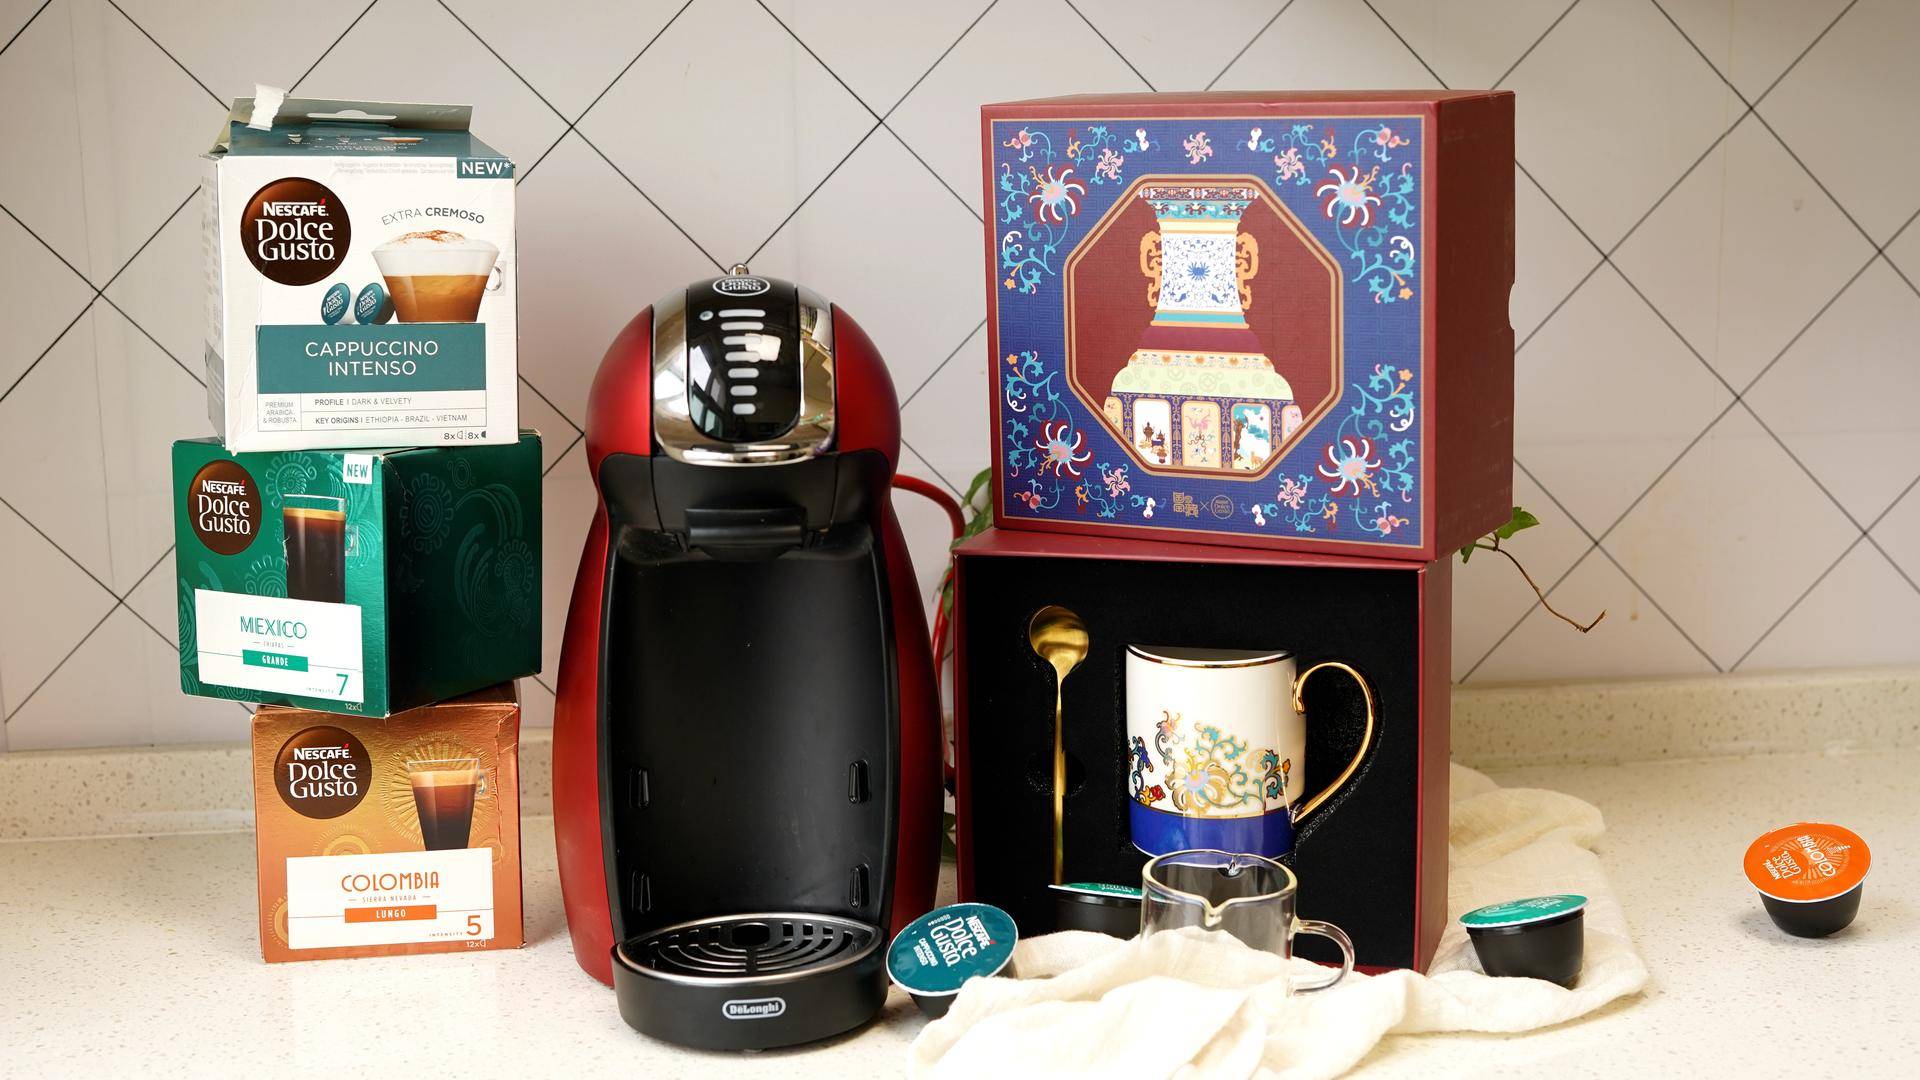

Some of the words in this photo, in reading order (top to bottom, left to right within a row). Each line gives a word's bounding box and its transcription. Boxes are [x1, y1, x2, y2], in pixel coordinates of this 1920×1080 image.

[381, 208, 423, 226] EXTRA
[425, 206, 485, 224] CREMOSO
[254, 217, 334, 241] Dolce
[257, 239, 336, 261] Gusto
[305, 340, 439, 357] CAPPUCCINO
[328, 360, 417, 377] INTENSO
[314, 398, 345, 406] PROFILE
[351, 397, 372, 406] DARK
[380, 396, 412, 405] VELVETY
[268, 416, 297, 424] ROBUSTA
[315, 416, 331, 425] KEY
[331, 415, 359, 425] ORIGINS
[365, 415, 399, 424] ETHIOPIA
[405, 414, 430, 423] BRAZIL
[436, 413, 468, 422] VIETNAM
[346, 463, 369, 479] NEW
[196, 494, 250, 518] Dolce
[199, 512, 251, 535] Gusto
[240, 615, 308, 639] MEXICO
[261, 654, 289, 667] GRANDE
[336, 673, 349, 696] 7
[286, 760, 357, 782] Dolce
[289, 779, 359, 799] Gusto
[1797, 835, 1838, 878] COLOMBIA
[341, 871, 440, 893] COLOMBIA
[362, 895, 388, 903] SIERRA
[389, 894, 417, 902] NEVADA
[375, 908, 407, 919] LUNGO
[466, 914, 483, 937] 5
[930, 924, 961, 968] Gusto
[944, 916, 978, 960] Dolce
